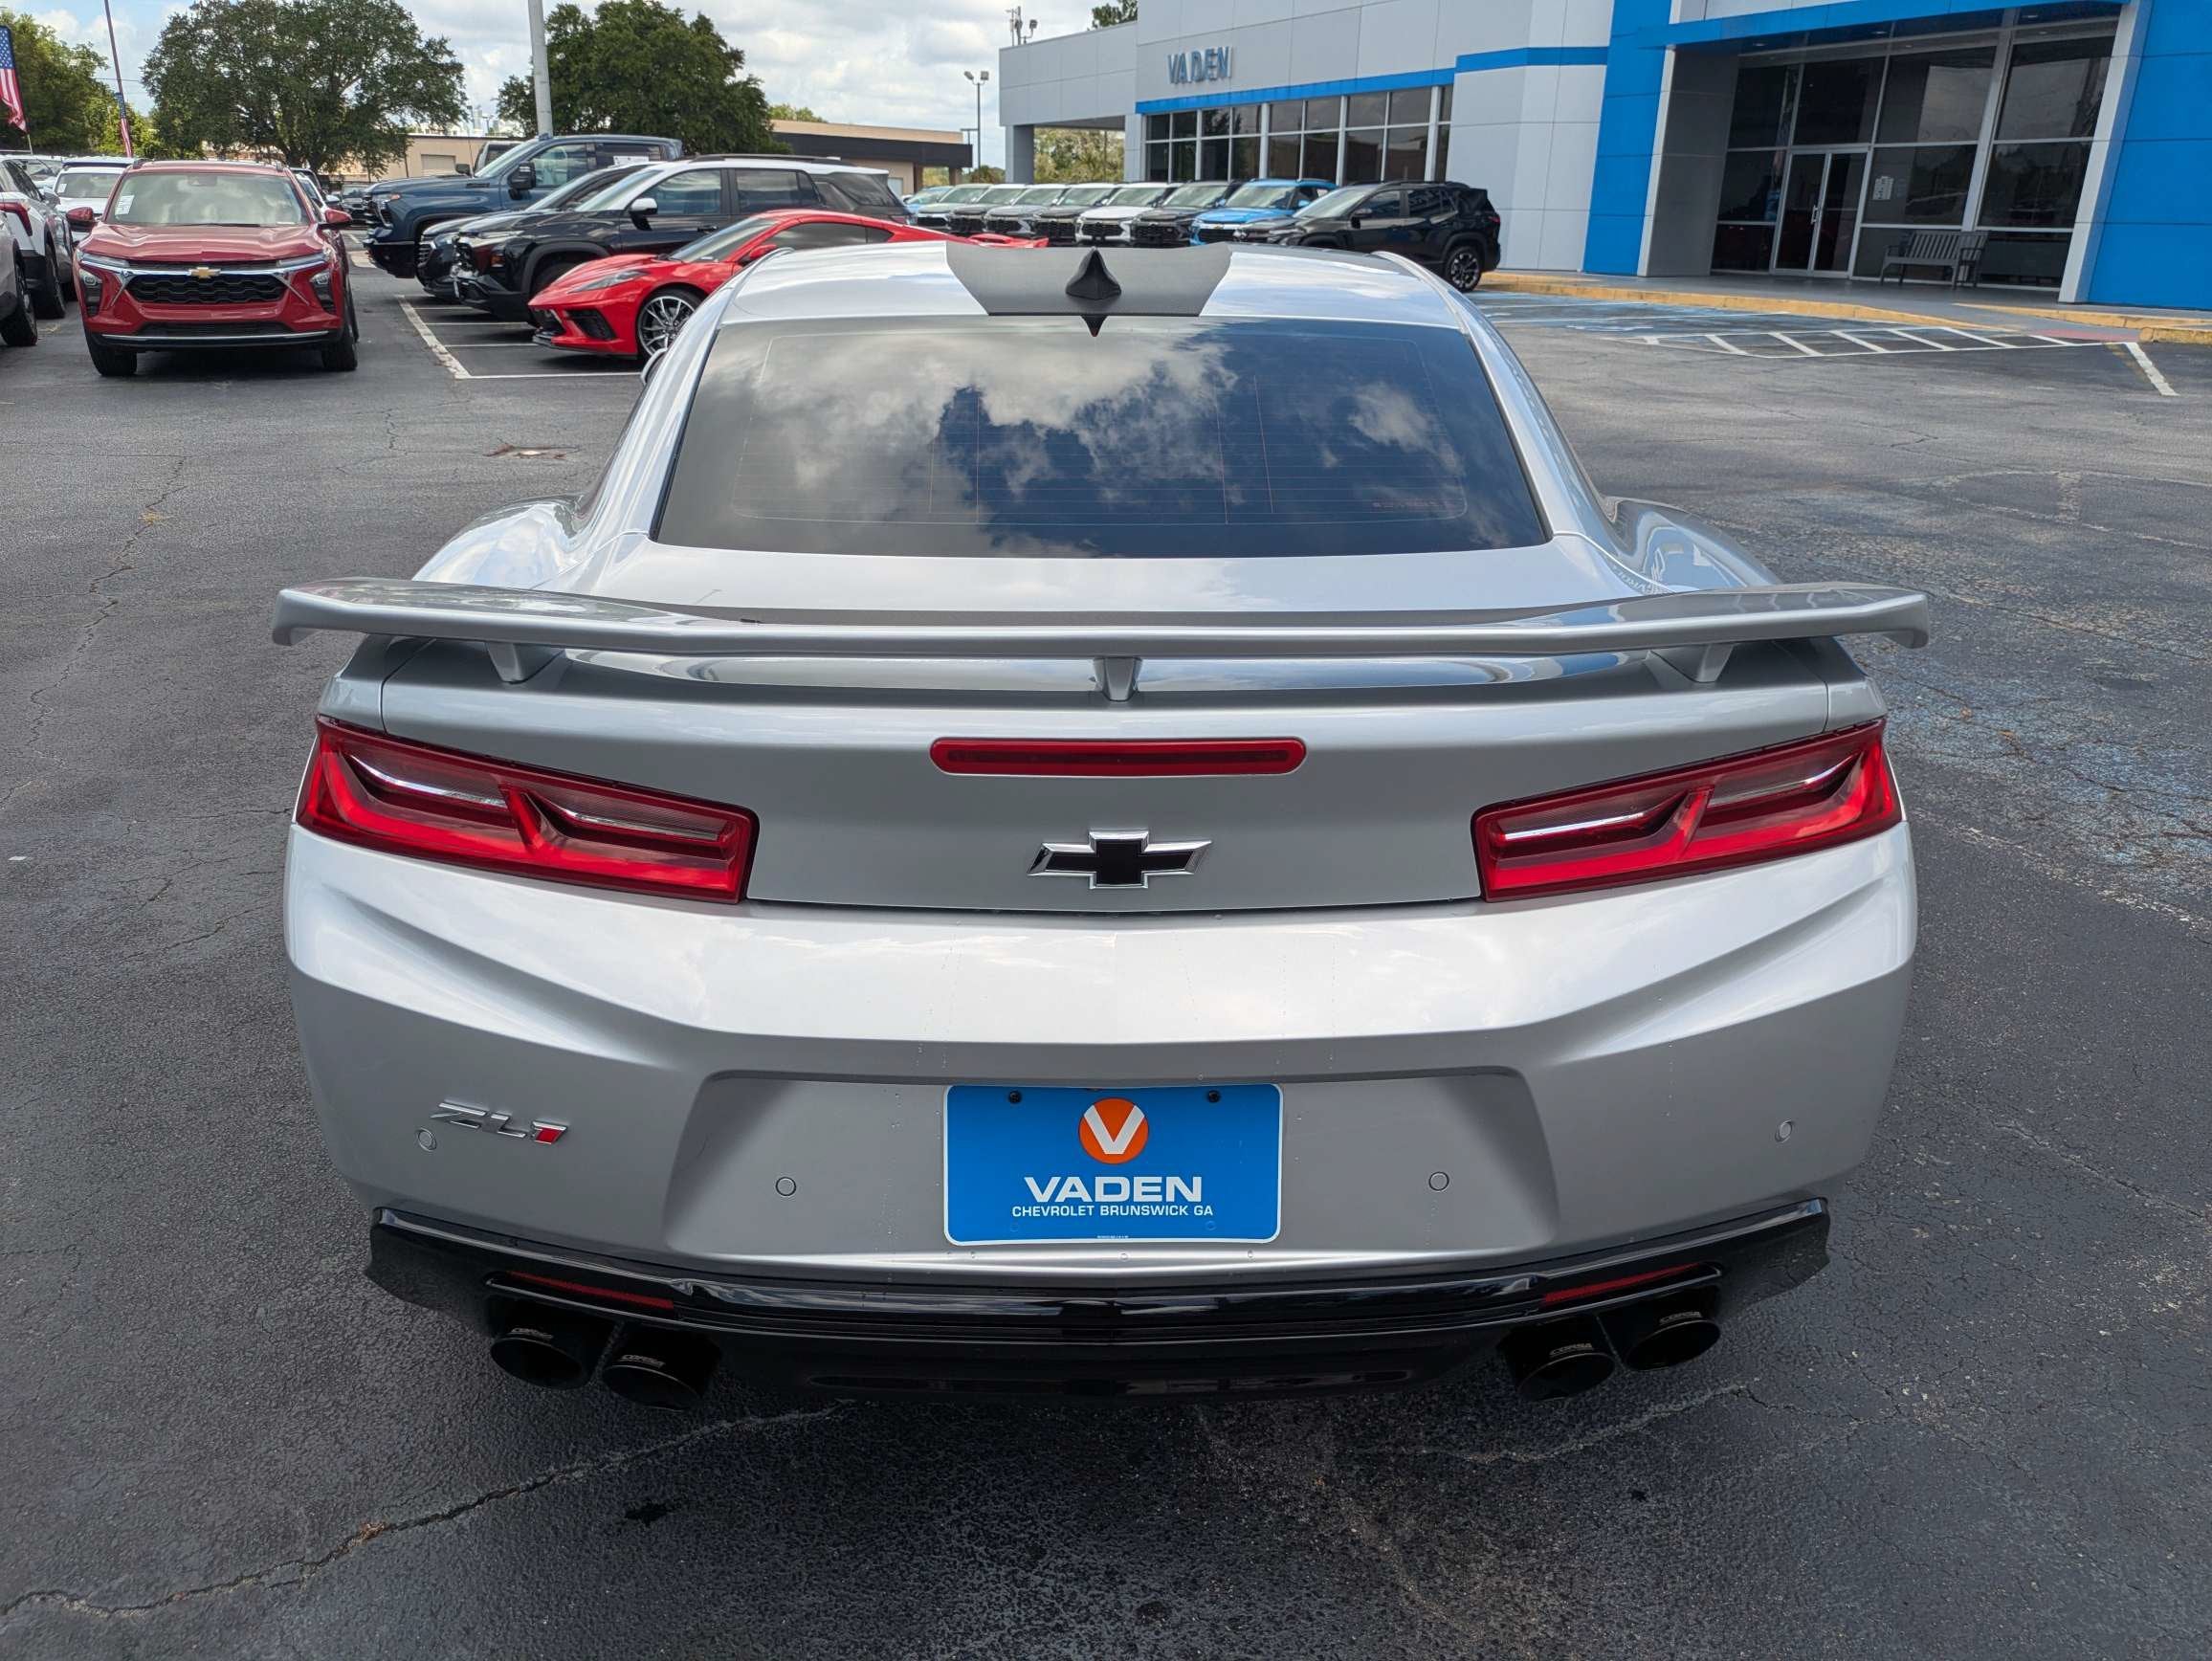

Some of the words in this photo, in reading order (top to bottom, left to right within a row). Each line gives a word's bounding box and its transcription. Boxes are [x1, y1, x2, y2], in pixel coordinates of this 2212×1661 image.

[1167, 46, 1231, 84] VADEN
[431, 1101, 567, 1145] ZL1
[1083, 1104, 1145, 1155] V
[1023, 1176, 1203, 1203] VADEN
[1012, 1206, 1095, 1217] CHEVROLET
[1099, 1205, 1189, 1216] BRUNSWICK
[1193, 1205, 1214, 1216] GA
